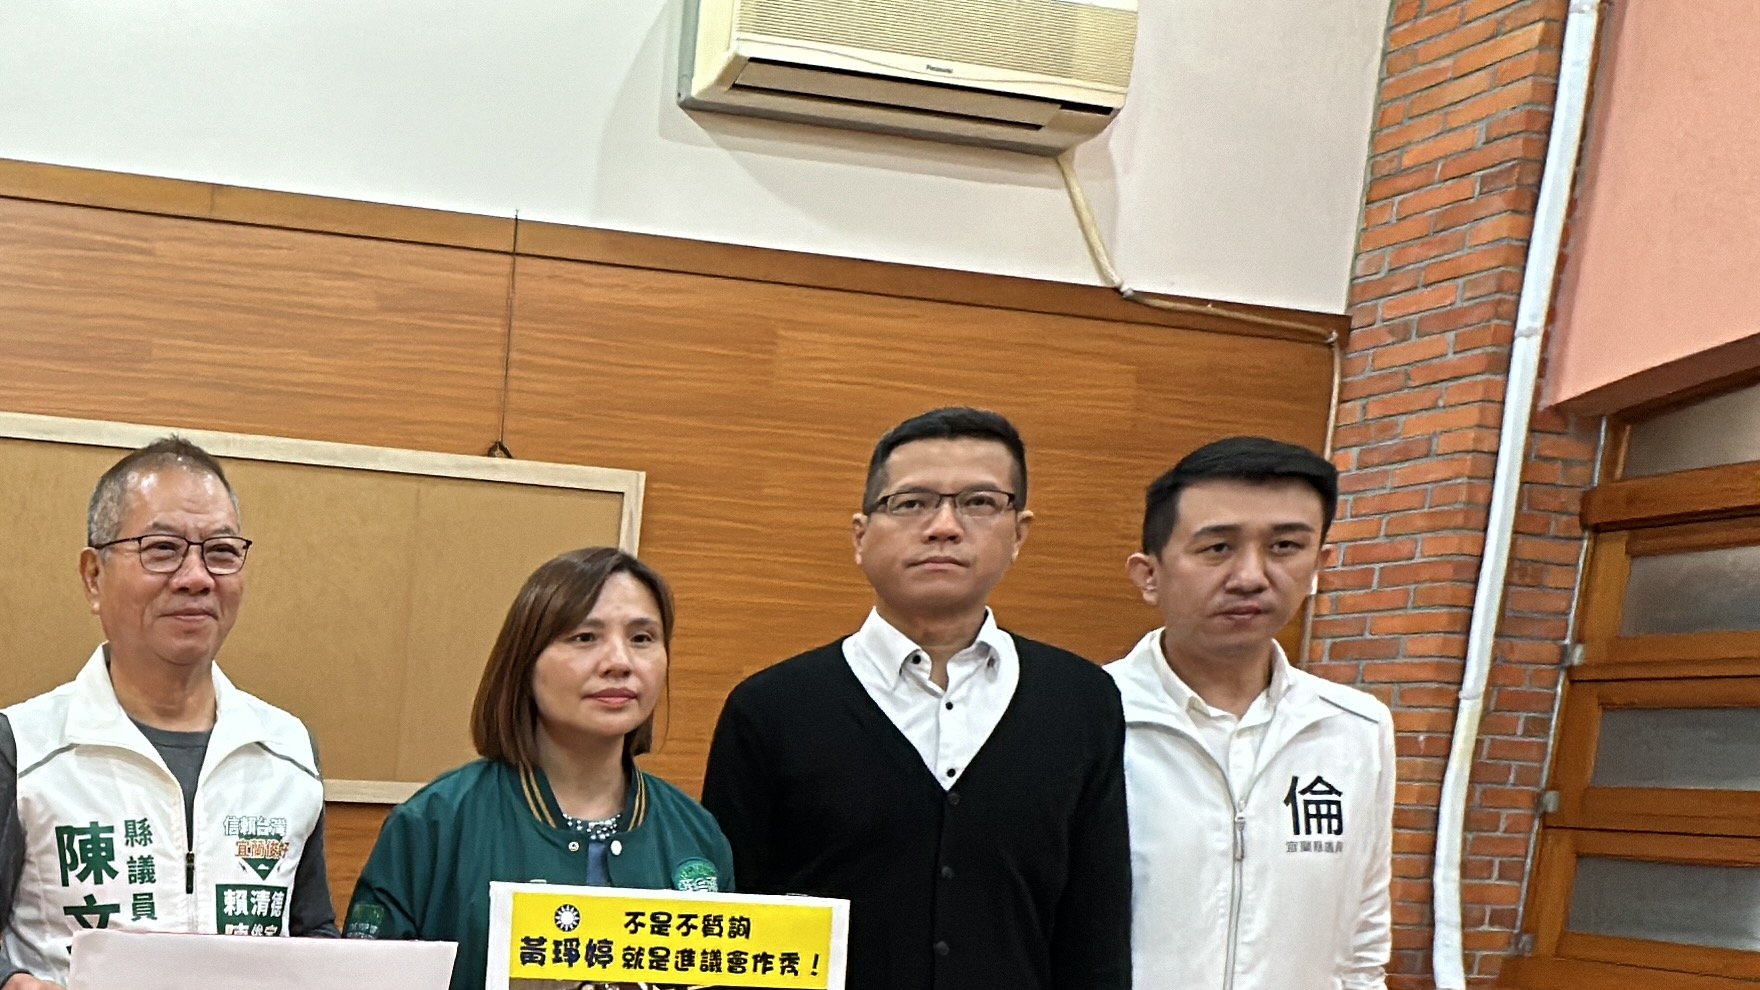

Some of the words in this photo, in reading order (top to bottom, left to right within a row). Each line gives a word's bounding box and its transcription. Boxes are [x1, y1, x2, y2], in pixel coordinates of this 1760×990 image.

[1283, 775, 1344, 836] 倫
[223, 815, 287, 836] 信賴台灣
[124, 817, 158, 922] 縣議員
[55, 821, 121, 955] 陳文
[223, 889, 285, 917] 賴清德
[623, 911, 752, 939] 不是不質詢
[519, 935, 614, 968] 黃琤婷
